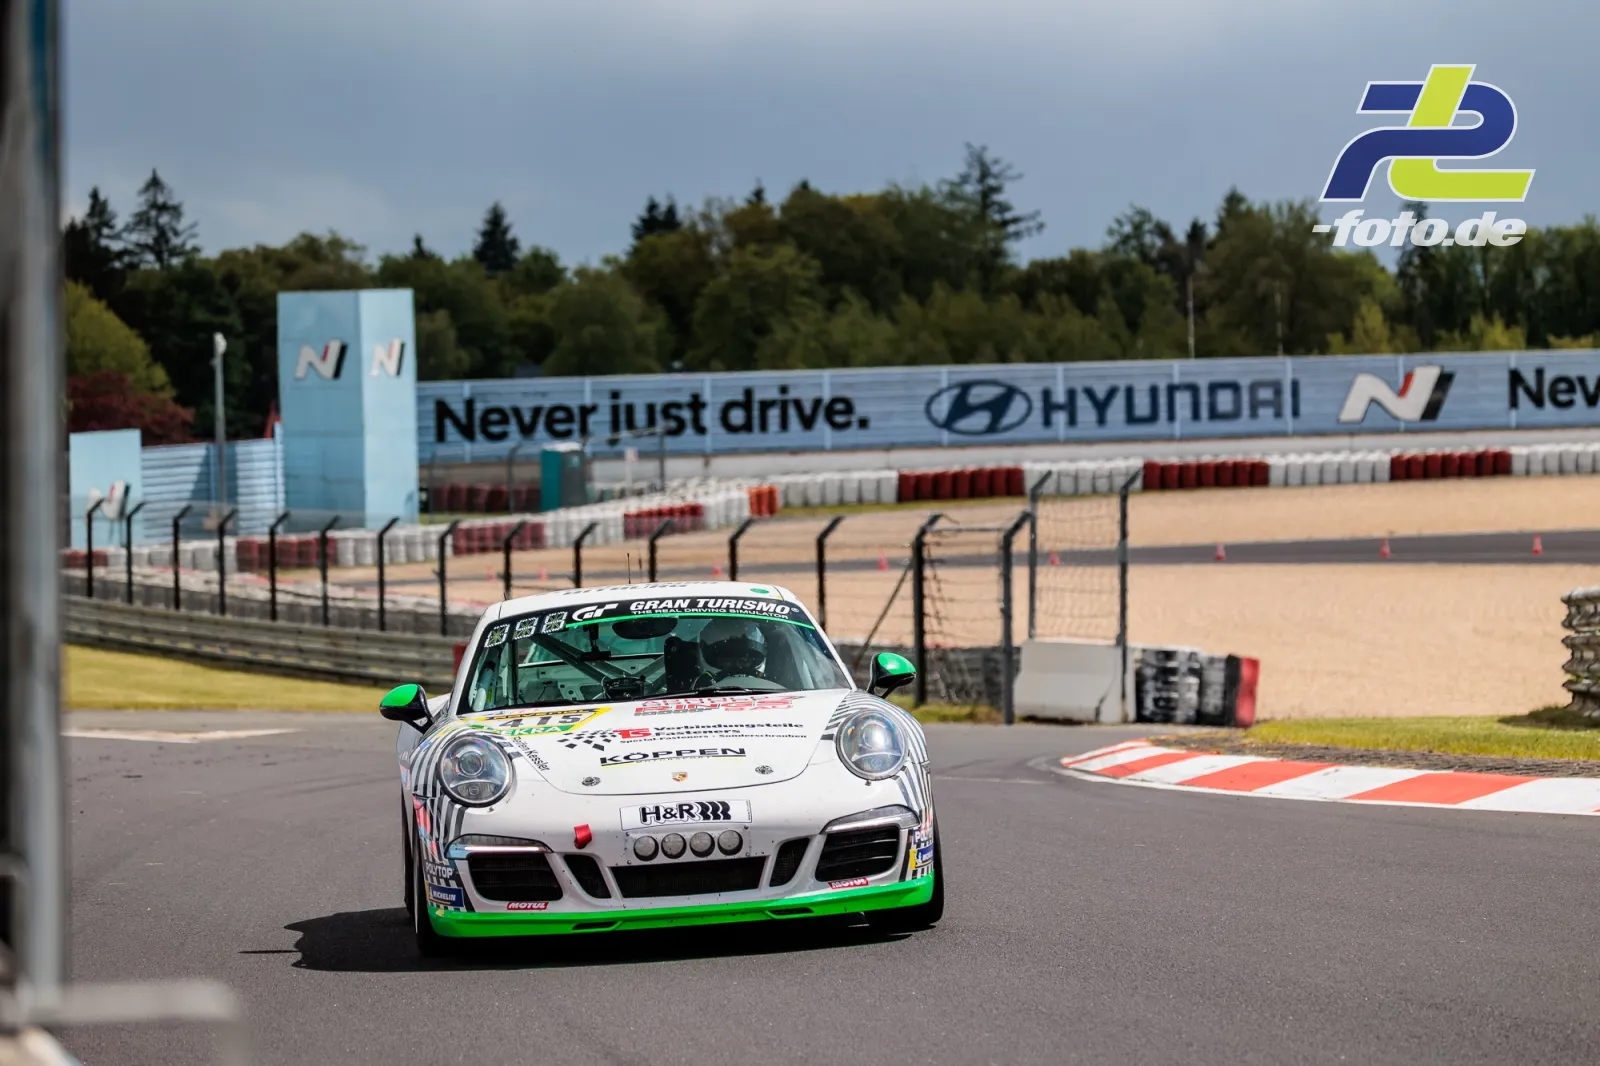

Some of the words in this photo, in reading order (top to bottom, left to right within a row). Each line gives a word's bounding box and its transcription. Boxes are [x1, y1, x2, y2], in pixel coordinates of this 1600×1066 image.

[1041, 378, 1300, 428] HYUNDAI
[434, 397, 598, 442] Never
[607, 388, 708, 447] just
[720, 384, 869, 434] drive.
[629, 599, 695, 611] GRAN
[728, 608, 789, 619] SIMULATOR
[499, 714, 582, 728] 415
[653, 723, 803, 732] Verbindungsteile
[655, 729, 741, 737] Fasteners
[525, 749, 550, 771] Kessler
[600, 748, 746, 764] KÖPPEN
[640, 802, 697, 824] H&R
[831, 878, 868, 889] MOTUL
[432, 890, 456, 901] MICHELIN
